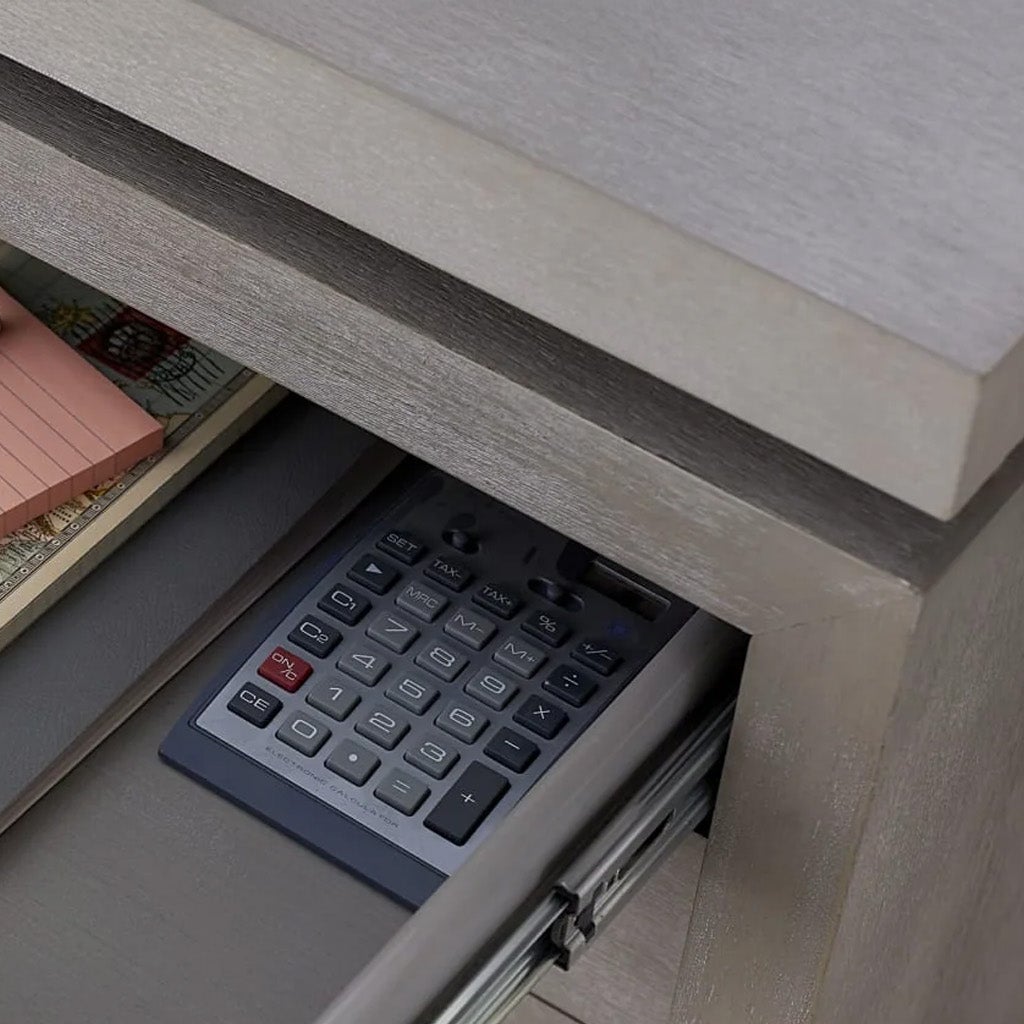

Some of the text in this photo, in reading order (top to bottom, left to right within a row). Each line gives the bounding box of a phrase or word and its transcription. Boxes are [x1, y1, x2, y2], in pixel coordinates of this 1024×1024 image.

[386, 533, 418, 552] SET
[406, 586, 439, 609] MRC
[385, 618, 409, 633] 7
[271, 652, 295, 669] ON
[352, 653, 376, 669] 4
[429, 647, 456, 668] 8
[504, 642, 537, 663] M+
[329, 687, 344, 701] 1
[399, 678, 426, 699] 5
[480, 675, 506, 694] 9
[239, 690, 270, 712] CE
[369, 712, 396, 733] 2
[449, 708, 475, 727] 6
[420, 742, 447, 762] 3
